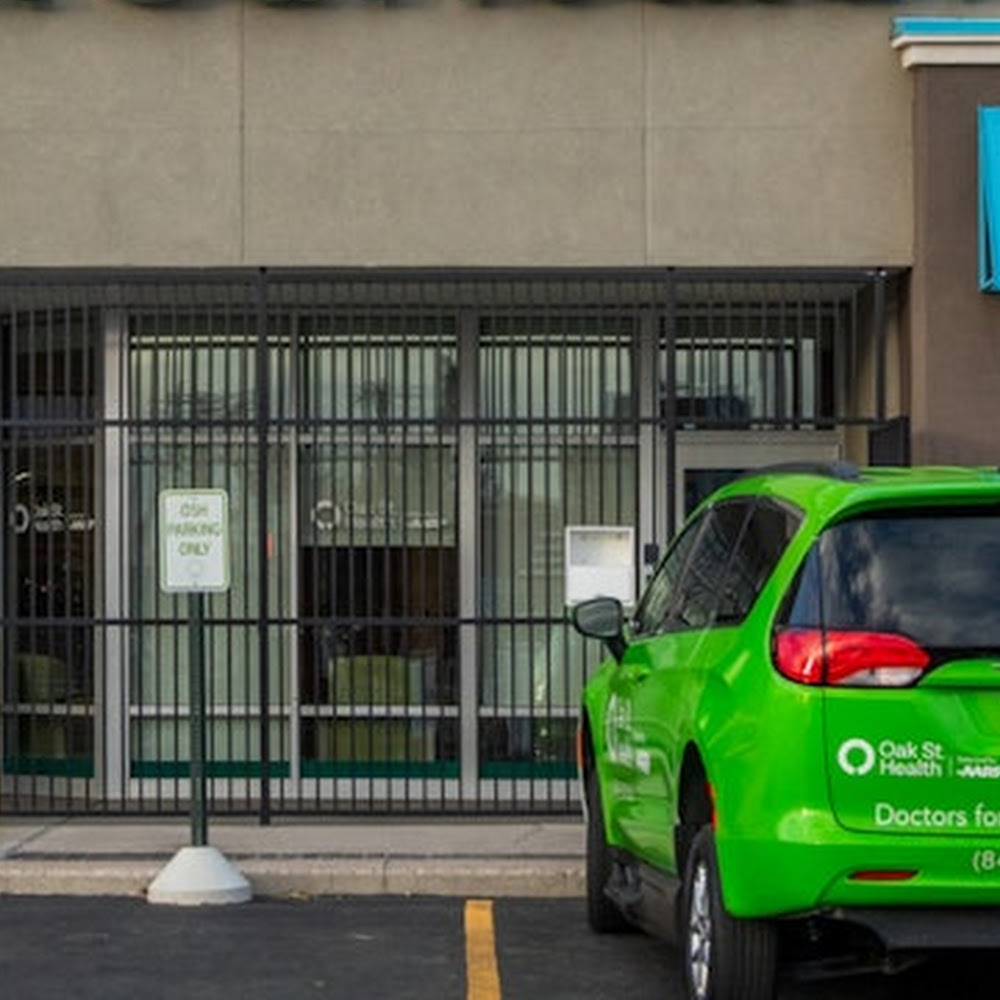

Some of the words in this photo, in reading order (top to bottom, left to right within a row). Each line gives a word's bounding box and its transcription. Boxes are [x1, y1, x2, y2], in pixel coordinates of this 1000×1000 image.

[879, 740, 918, 758] Oak
[879, 759, 942, 777] Health
[875, 803, 967, 827] Doctors
